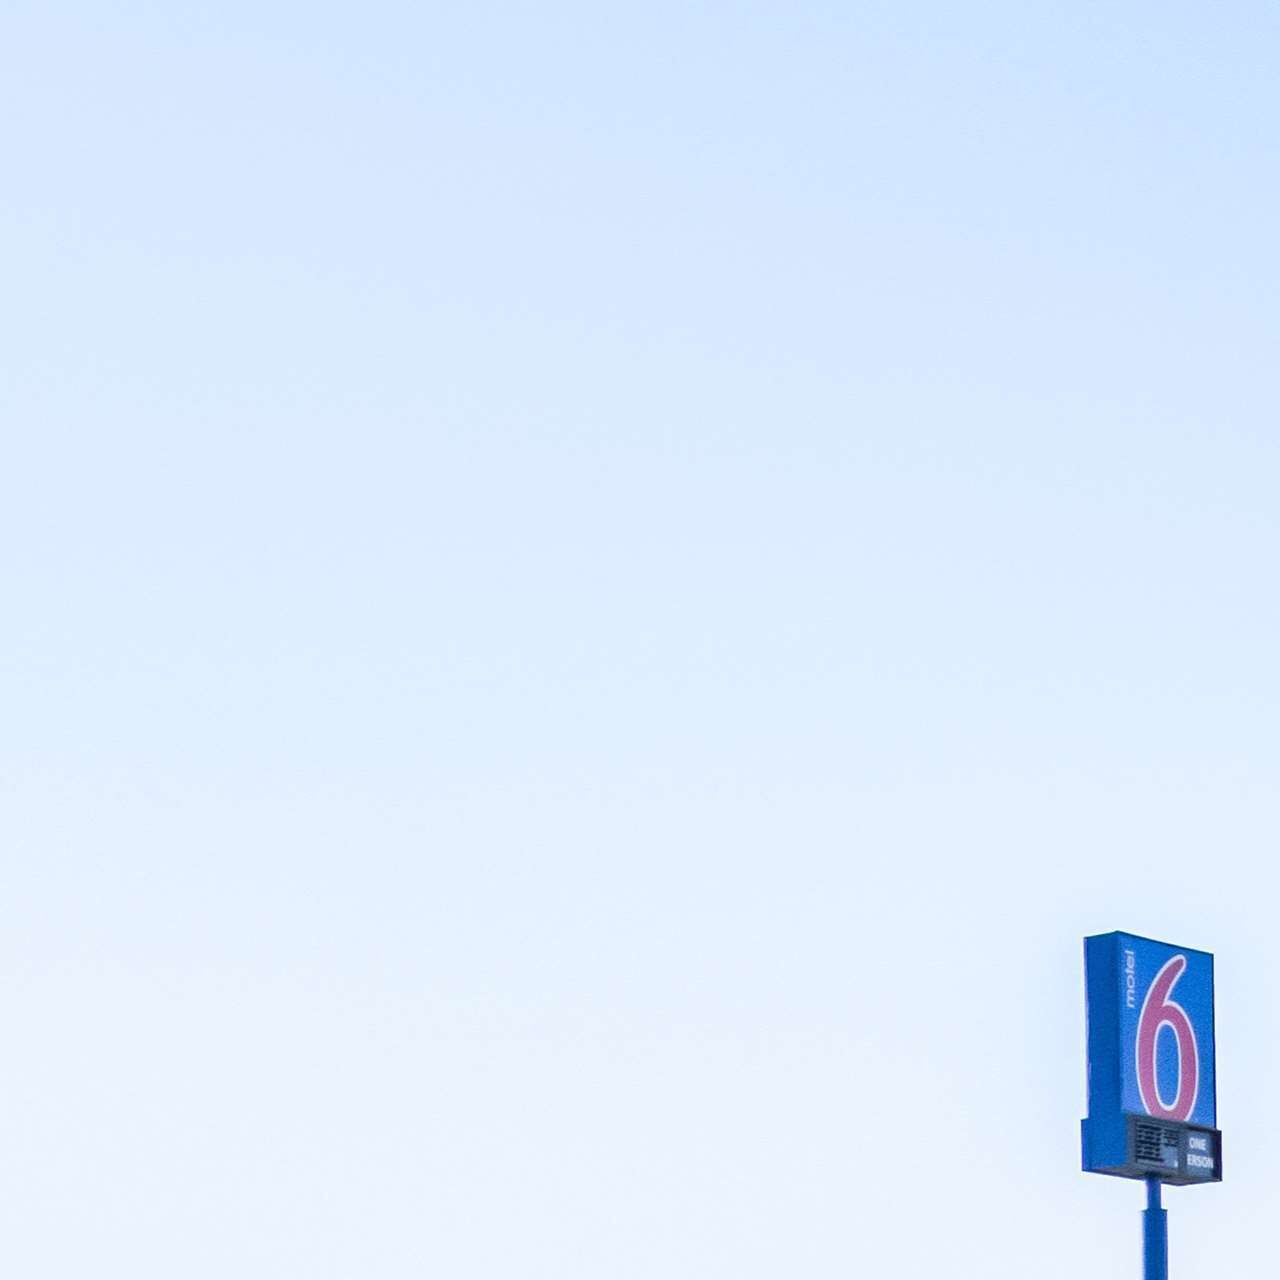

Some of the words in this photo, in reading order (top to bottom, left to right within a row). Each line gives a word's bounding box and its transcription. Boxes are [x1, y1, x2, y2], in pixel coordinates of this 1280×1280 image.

[1125, 949, 1136, 1009] motel
[1135, 954, 1200, 1122] 6
[1188, 1137, 1207, 1151] ONE
